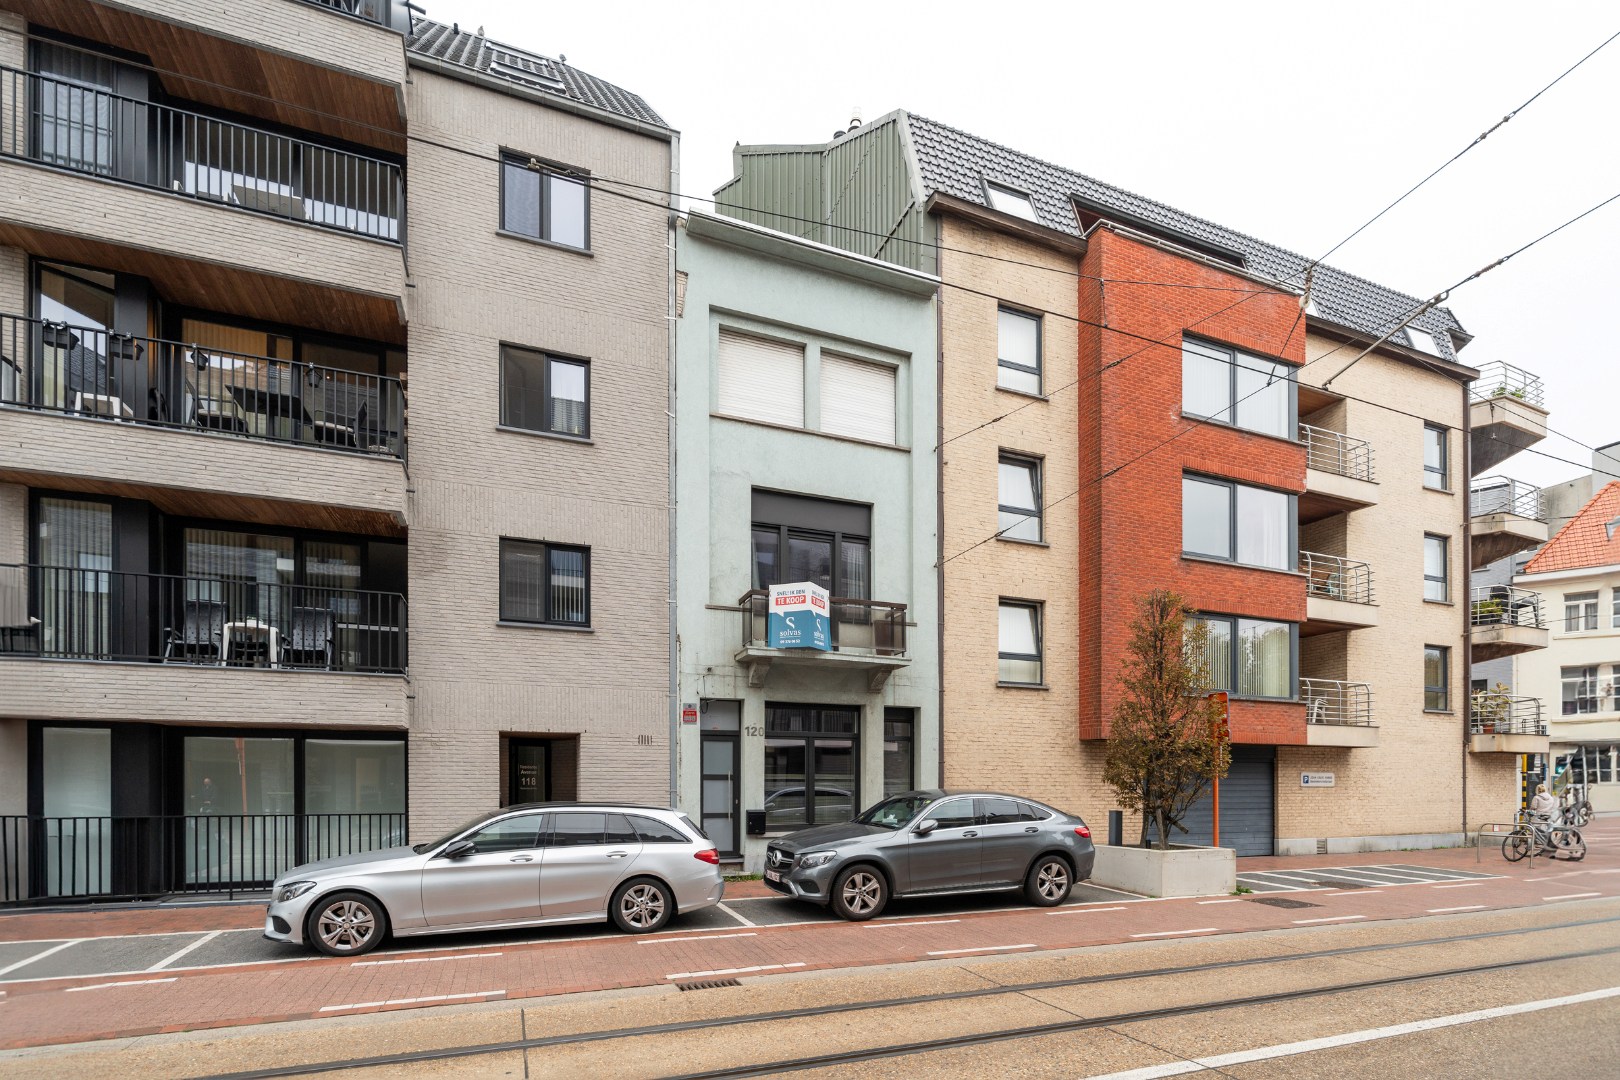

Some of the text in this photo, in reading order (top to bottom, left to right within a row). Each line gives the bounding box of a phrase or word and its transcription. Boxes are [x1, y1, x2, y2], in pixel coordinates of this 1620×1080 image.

[786, 596, 805, 604] KOOP
[745, 726, 764, 737] 120
[521, 777, 536, 786] 118
